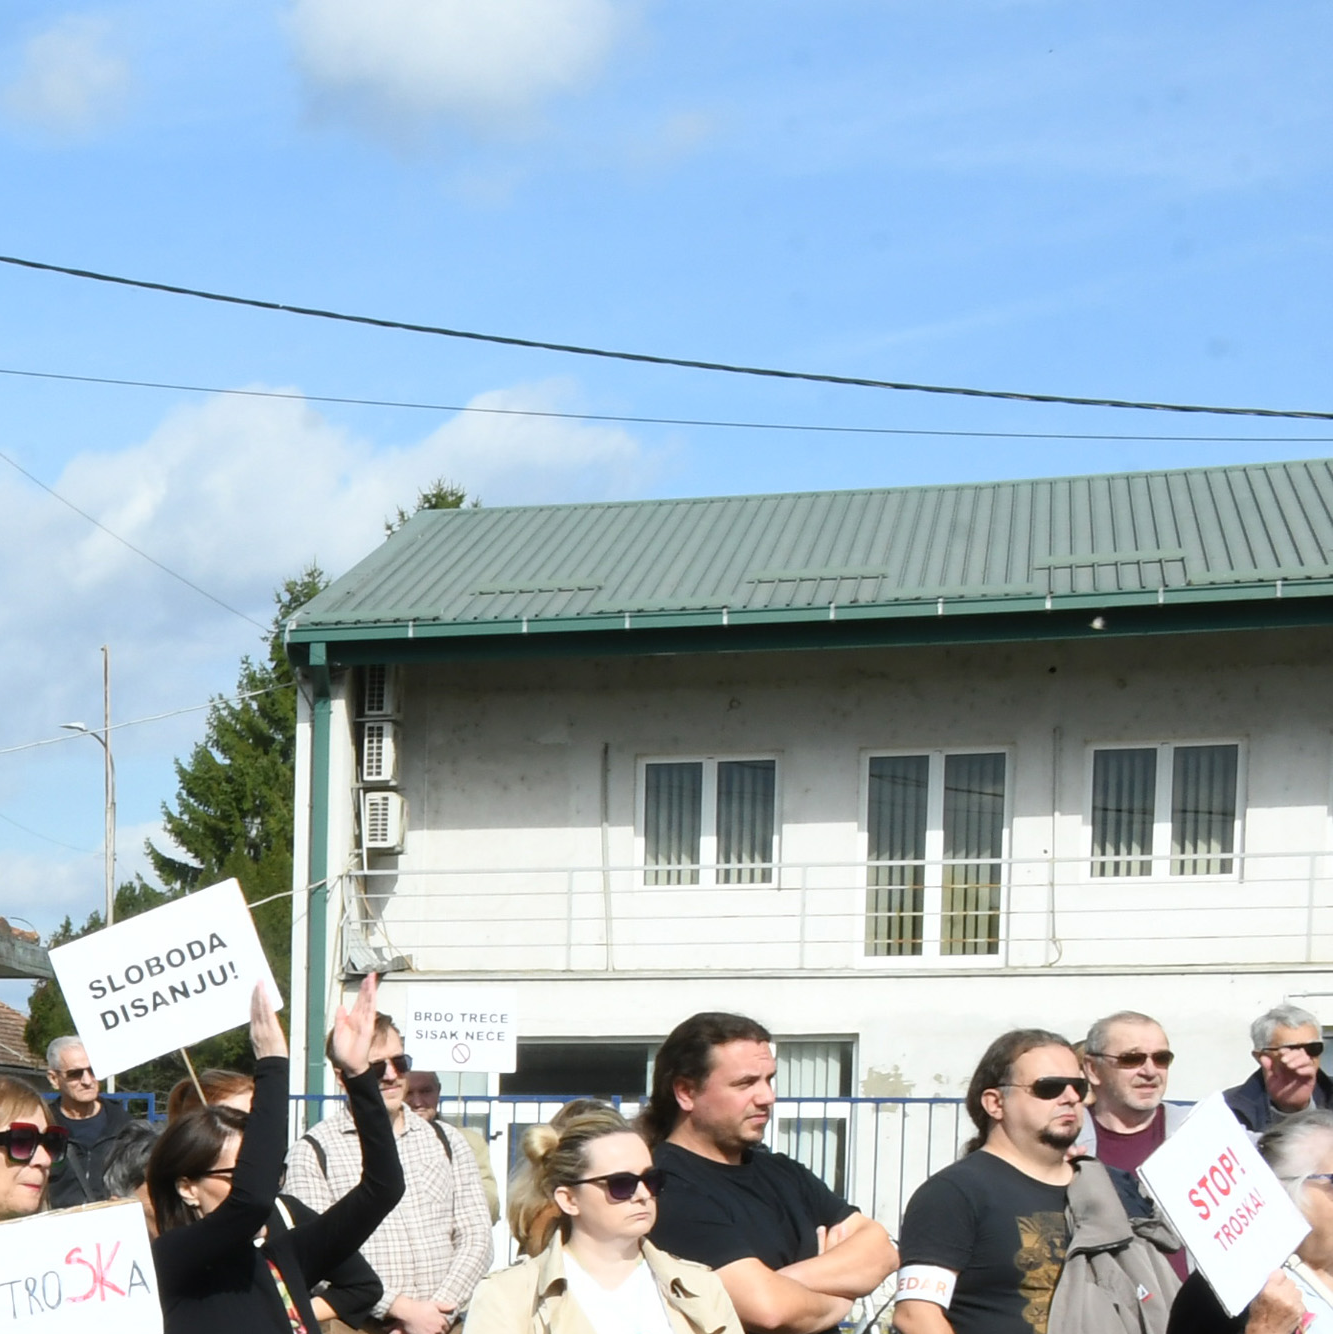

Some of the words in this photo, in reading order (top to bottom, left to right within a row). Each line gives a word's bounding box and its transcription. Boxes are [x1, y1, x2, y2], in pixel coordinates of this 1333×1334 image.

[89, 932, 227, 1000] SLOBODA
[100, 961, 239, 1031] DISANJU!
[414, 1011, 454, 1022] BRDO
[415, 1029, 459, 1040] SISAK
[1188, 1146, 1246, 1221] STOP!
[1213, 1187, 1266, 1252] TROSKA!
[0, 1240, 151, 1319] TROSKA
[898, 1276, 948, 1297] EDAR
